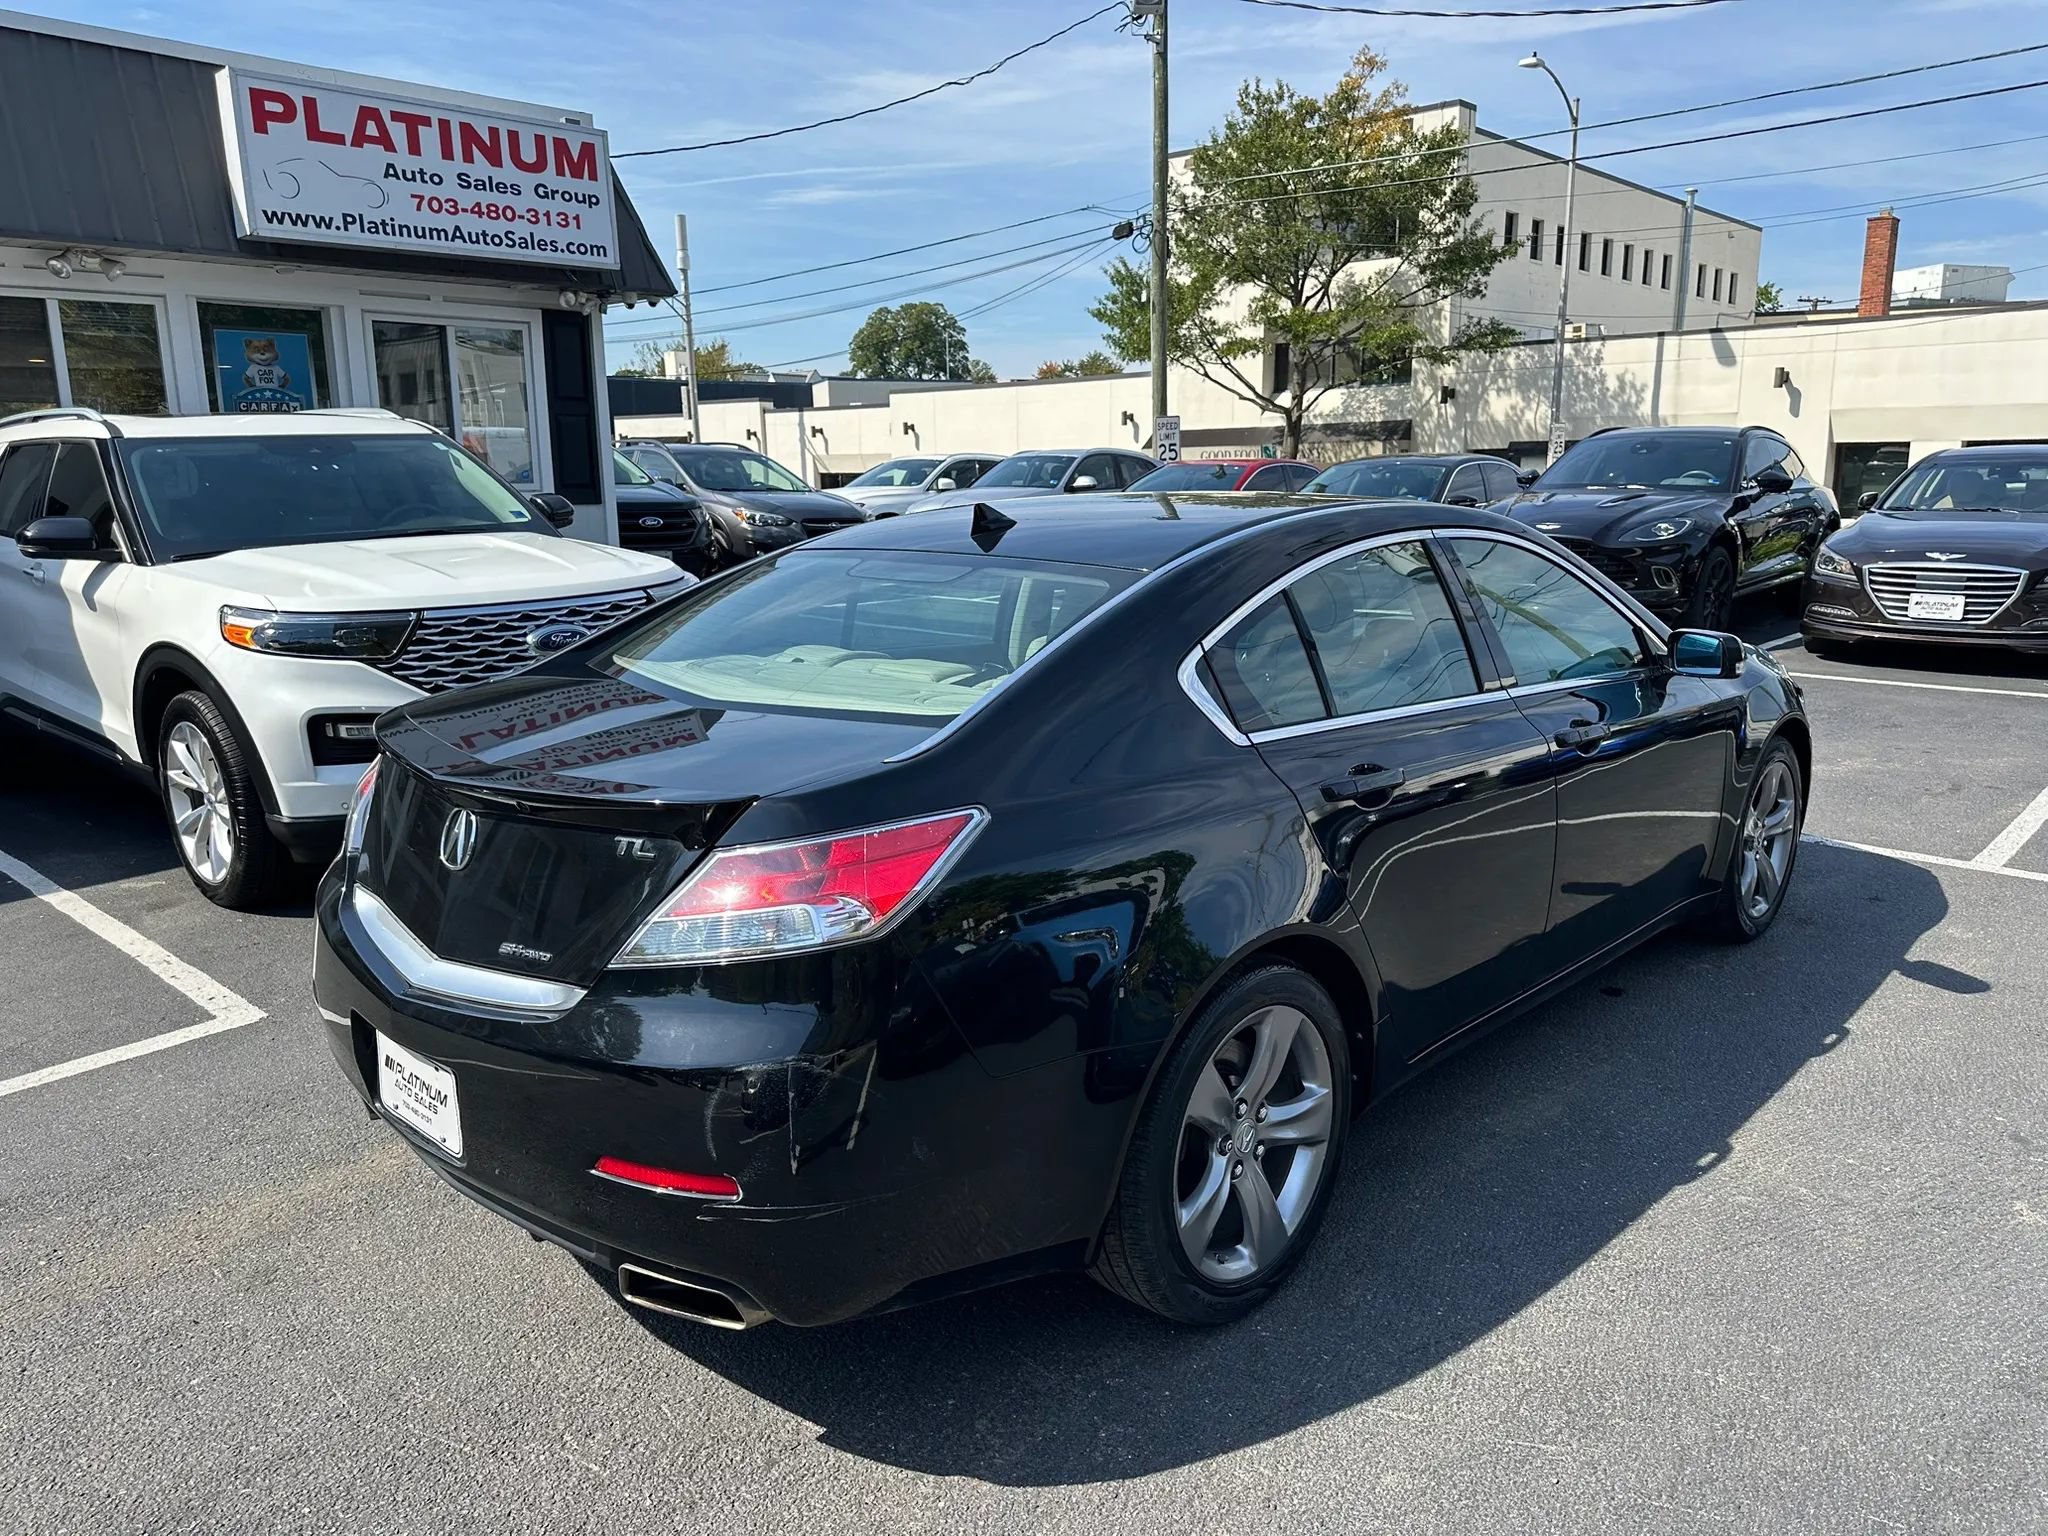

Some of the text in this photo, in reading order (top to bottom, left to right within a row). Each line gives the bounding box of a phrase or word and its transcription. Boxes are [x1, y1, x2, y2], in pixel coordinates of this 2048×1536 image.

[250, 87, 599, 182] PLATINUM
[383, 162, 601, 208] Auto Sales Group
[410, 193, 583, 231] 703-480-3131
[261, 207, 609, 259] www.PlatinumAutoSales.com
[259, 377, 275, 385] FOX
[240, 402, 299, 412] CARFAX
[1157, 421, 1179, 431] SPEED
[1159, 432, 1177, 441] LIMIT
[1158, 443, 1179, 462] 25
[1200, 449, 1232, 459] GOOD
[1553, 441, 1563, 454] 25
[550, 631, 580, 648] Ford
[614, 836, 656, 859] TL
[395, 1062, 447, 1108] PLATINUM
[394, 1078, 438, 1115] AUTO SALES
